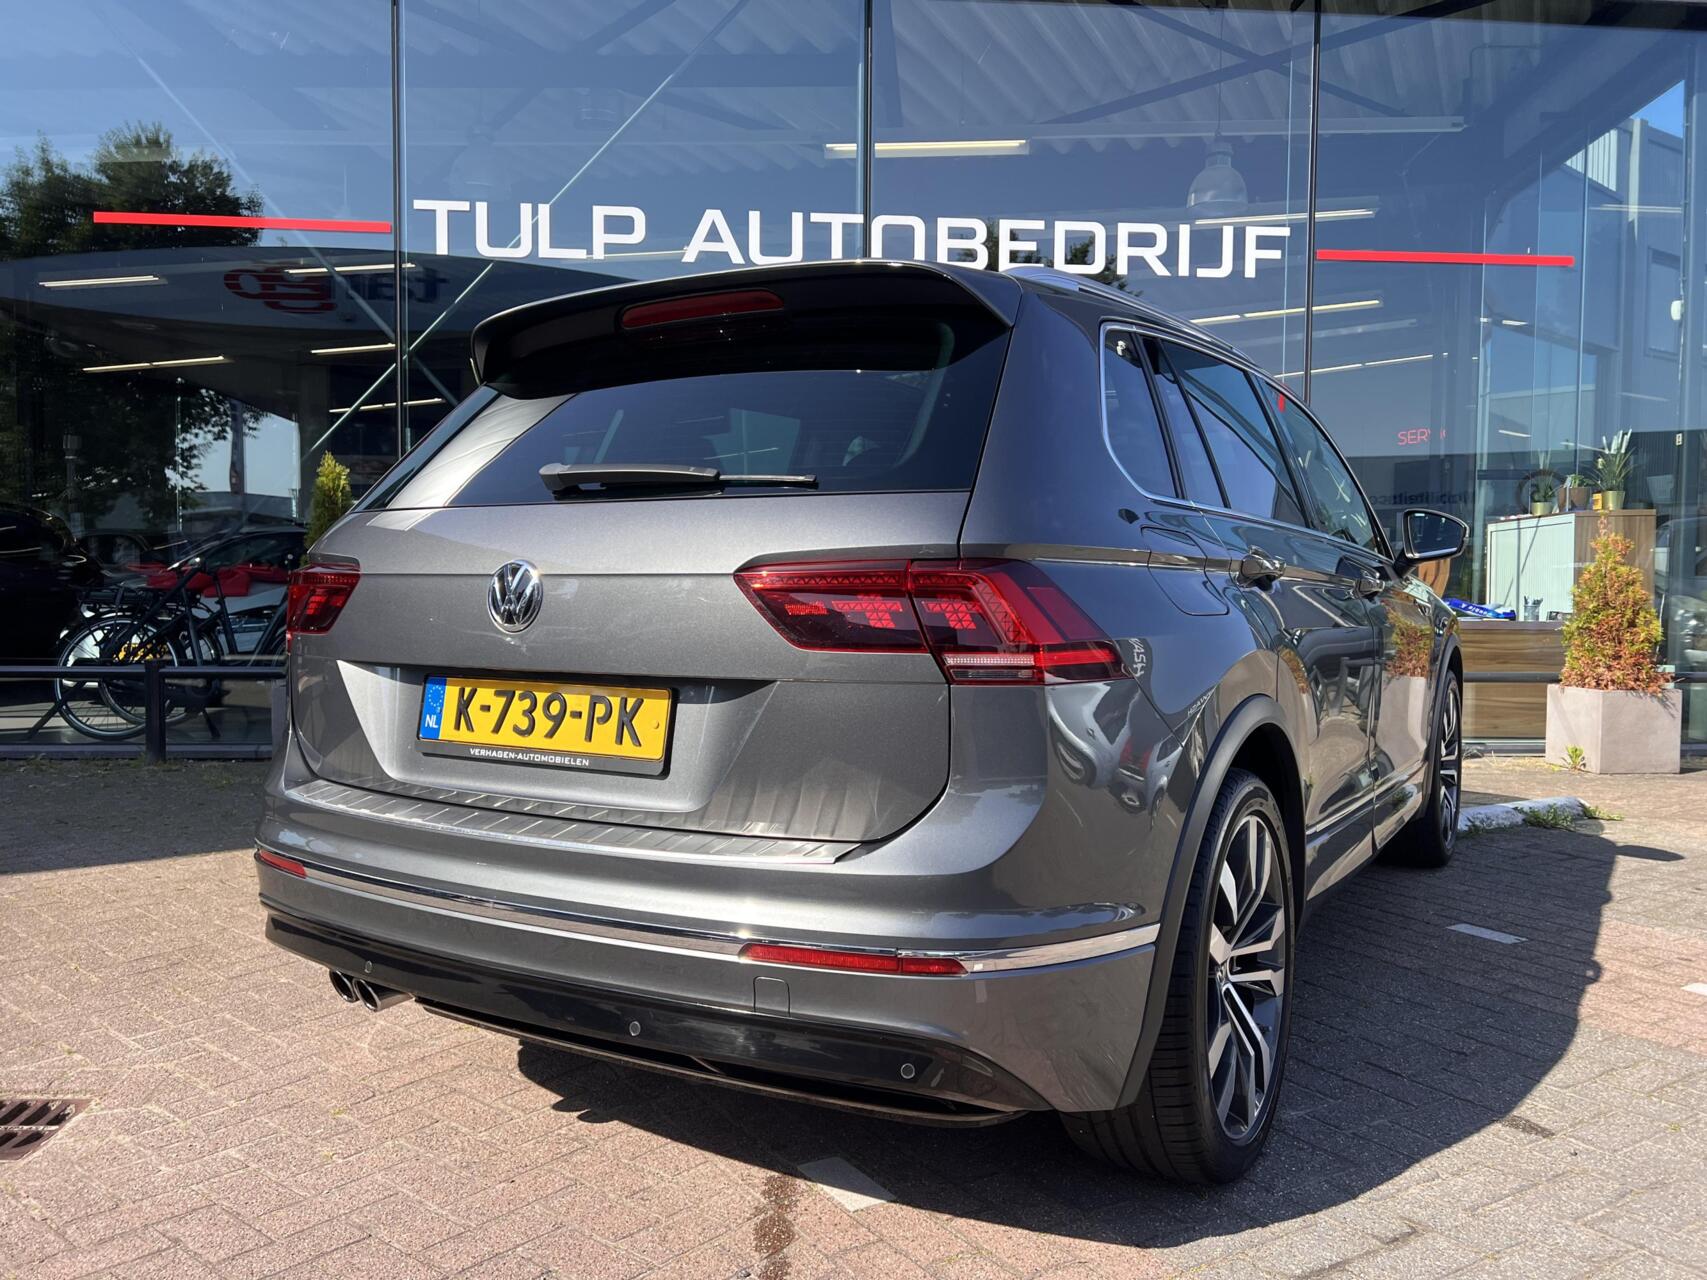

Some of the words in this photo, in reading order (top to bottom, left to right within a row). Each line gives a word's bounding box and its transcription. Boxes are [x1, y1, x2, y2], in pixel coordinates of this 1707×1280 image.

[413, 199, 646, 260] TULP
[681, 208, 1291, 279] AUTOBEDRIJF
[424, 713, 439, 729] NL
[453, 686, 645, 748] K-739-PK
[469, 747, 590, 767] VERHAGEN-AUTOMOBIELEN
